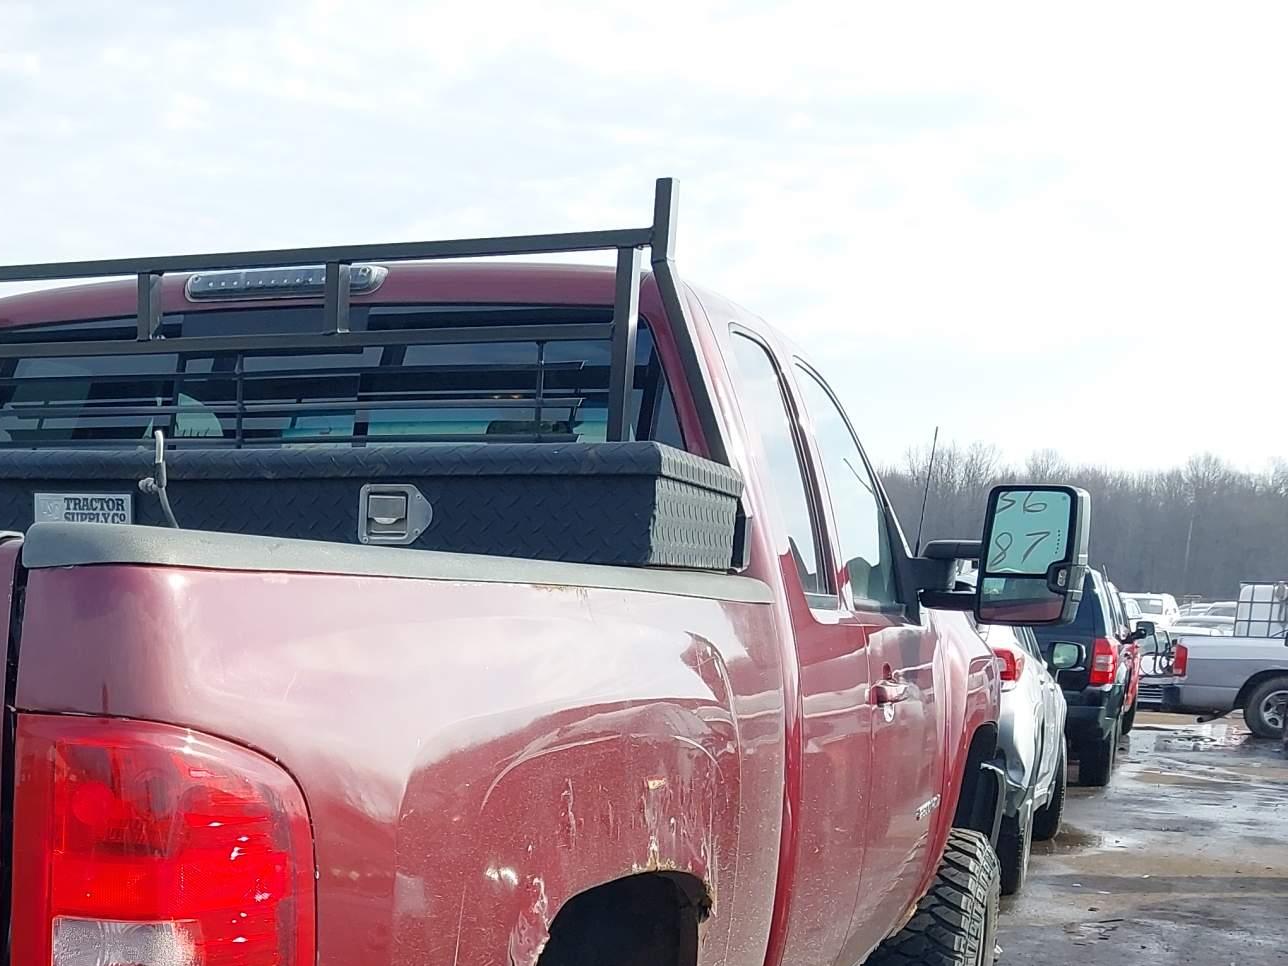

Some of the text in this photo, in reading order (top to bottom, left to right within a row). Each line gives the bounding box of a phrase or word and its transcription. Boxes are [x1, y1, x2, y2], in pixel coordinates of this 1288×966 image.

[63, 497, 126, 511] TRACTOR
[64, 511, 109, 523] SUPPLY
[989, 531, 1051, 566] 87
